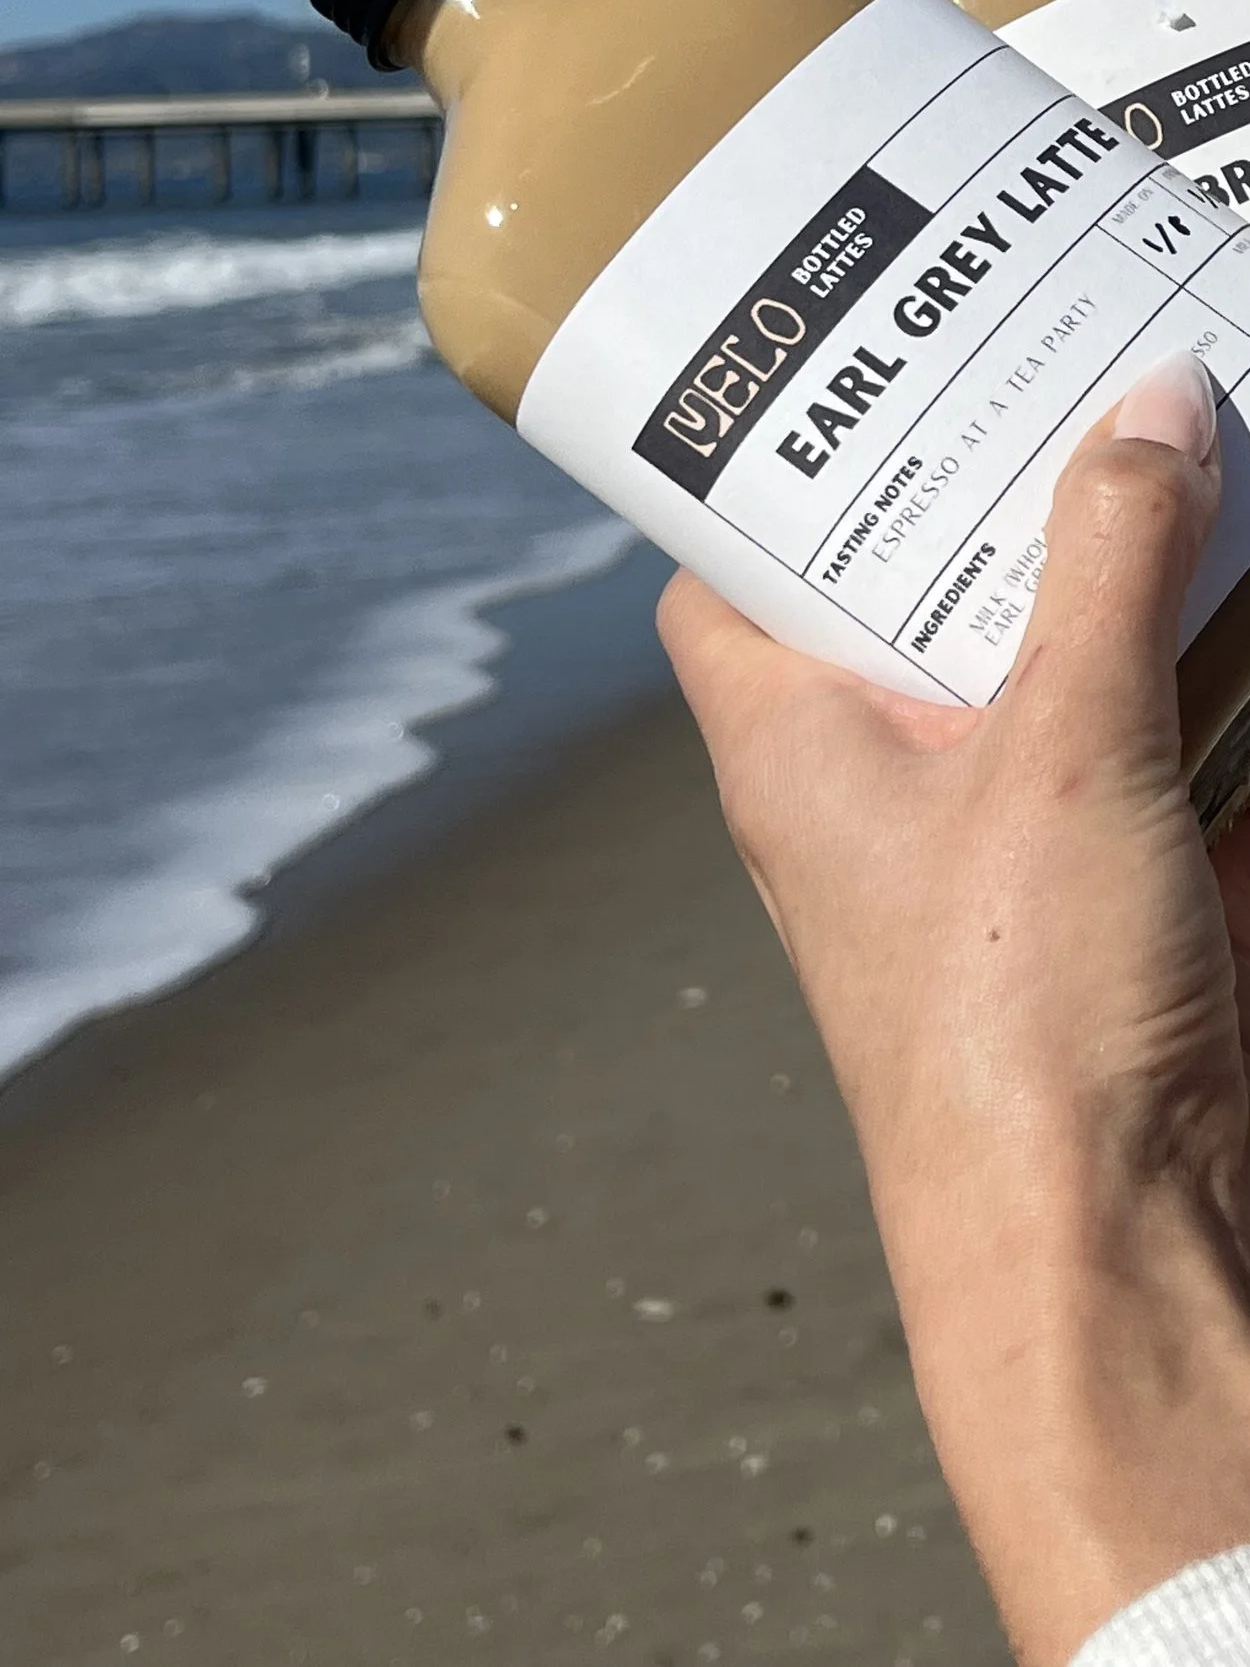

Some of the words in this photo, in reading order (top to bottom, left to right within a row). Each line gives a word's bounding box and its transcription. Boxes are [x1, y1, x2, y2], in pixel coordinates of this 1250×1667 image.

[1179, 85, 1250, 126] LATTES
[791, 207, 866, 285] BOTTLED
[810, 233, 873, 298] LATTES
[775, 345, 908, 479] EARL
[893, 211, 1012, 338] GREY
[996, 117, 1120, 223] LATTE
[871, 456, 960, 564] ESPRESSO
[961, 420, 988, 451] AT
[989, 398, 1009, 417] A
[1005, 355, 1045, 392] TEA
[1040, 292, 1097, 353] PARTY
[822, 511, 879, 585] TASTING
[874, 455, 923, 513] NOTES
[911, 542, 996, 653] INGREDIENTS
[969, 590, 1007, 633] MILK
[984, 602, 1025, 646] EARL
